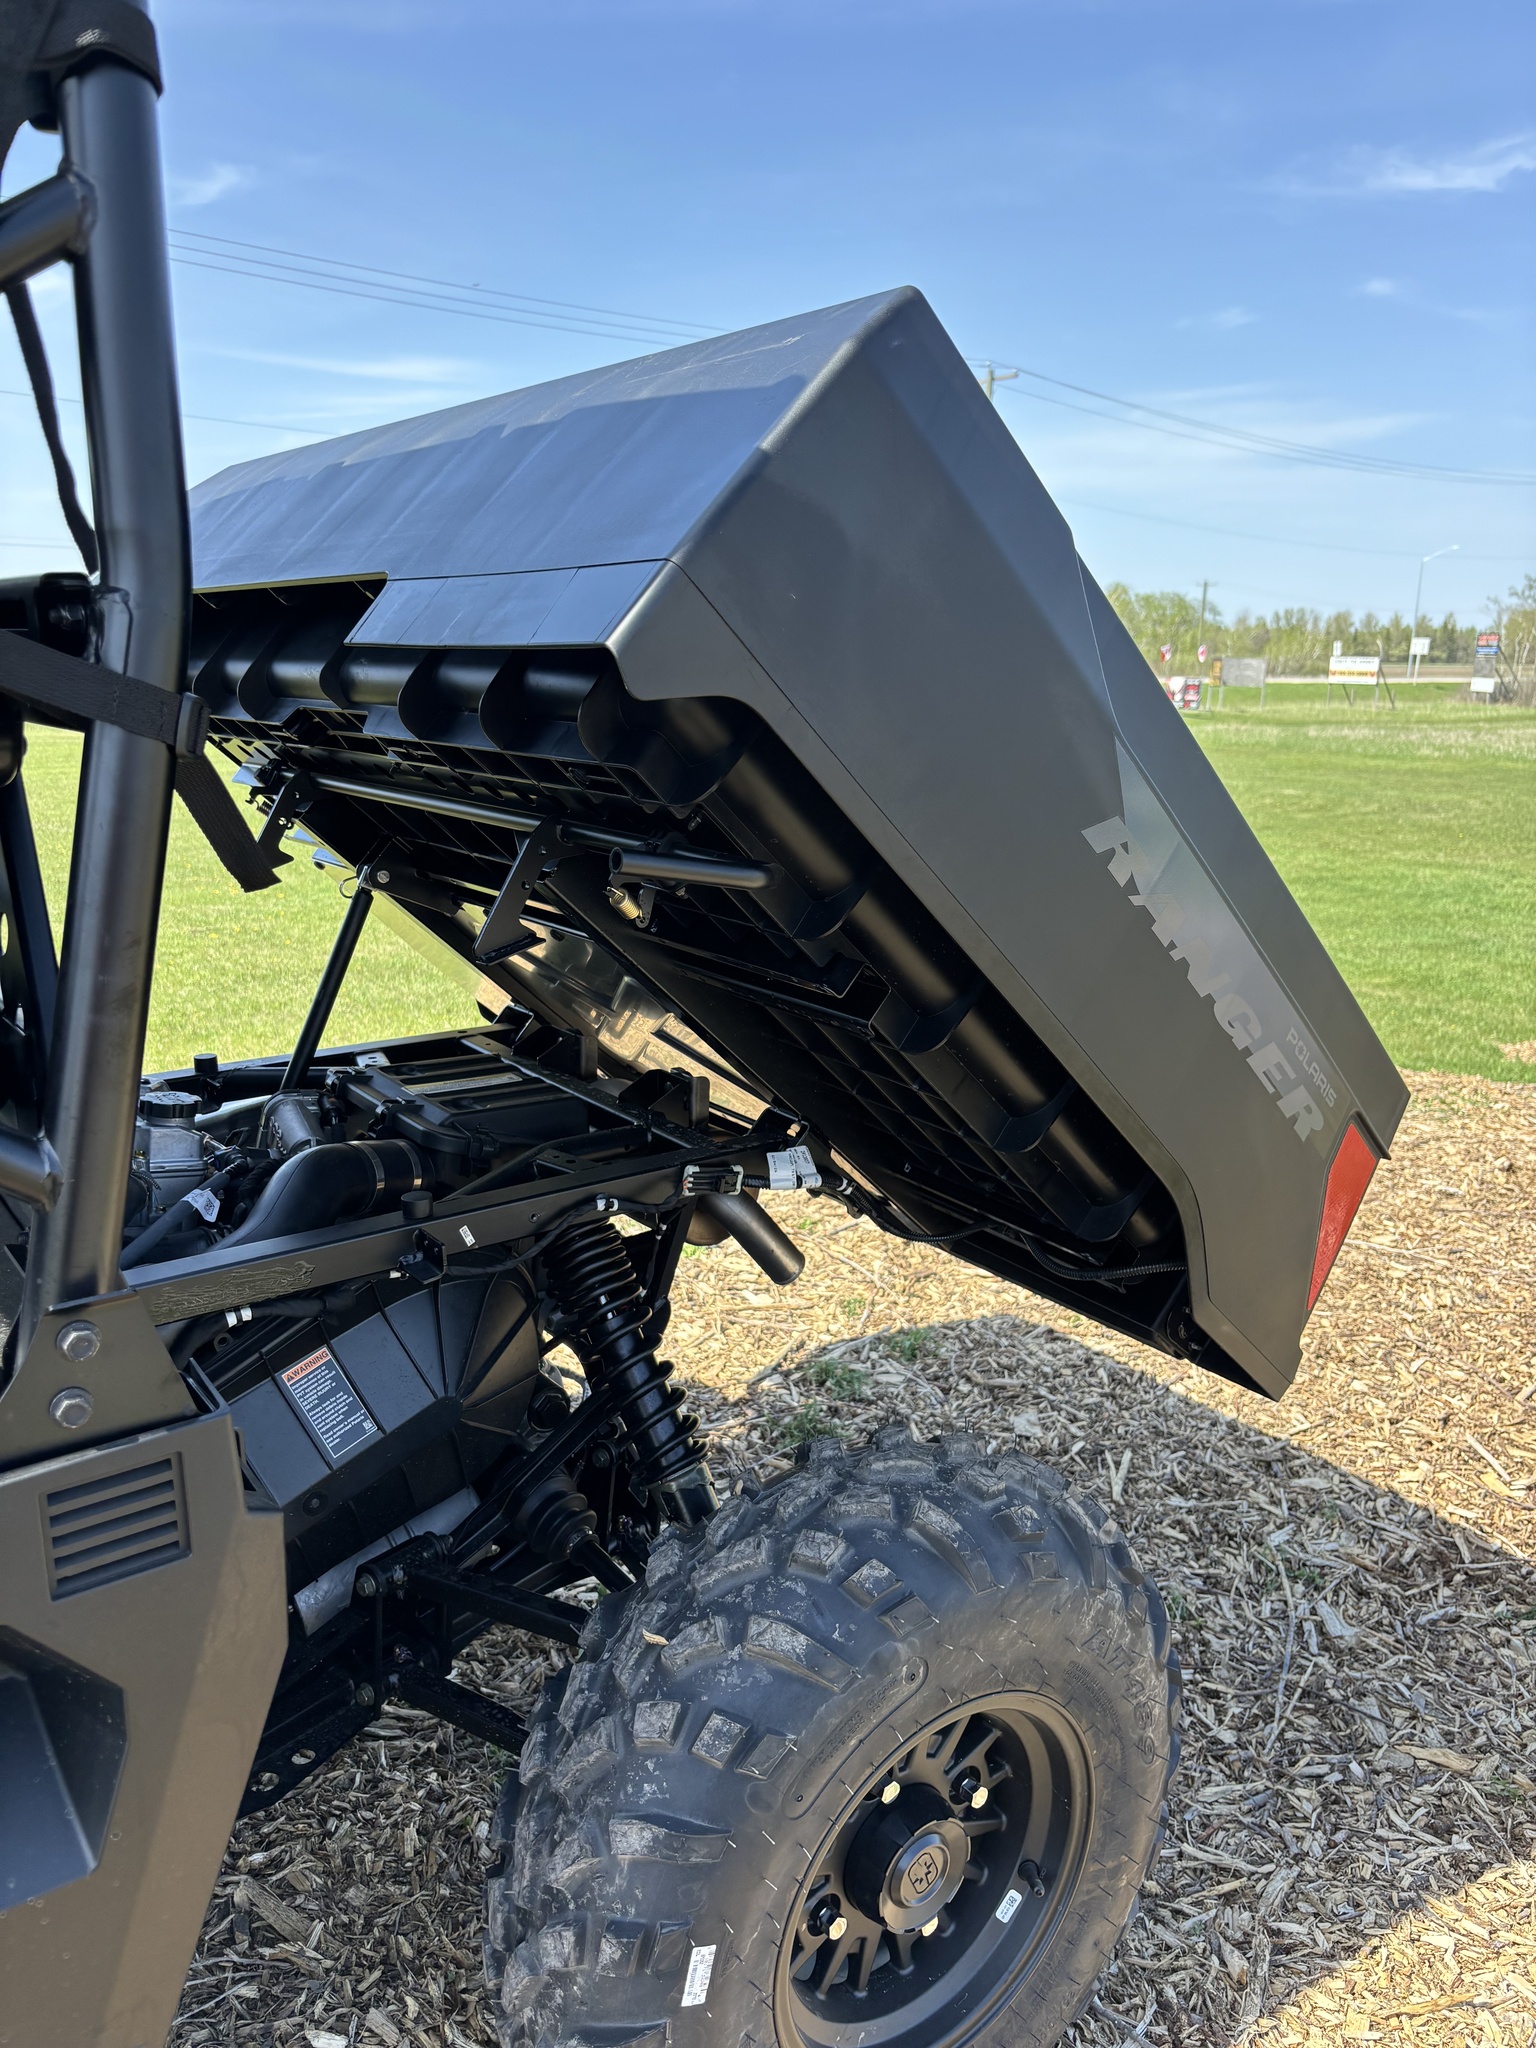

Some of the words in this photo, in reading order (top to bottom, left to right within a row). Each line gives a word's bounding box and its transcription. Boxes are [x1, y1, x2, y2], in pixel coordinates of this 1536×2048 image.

[1081, 816, 1325, 1143] RANGER
[1285, 1026, 1337, 1109] POLARIS
[291, 1351, 329, 1377] WARNING
